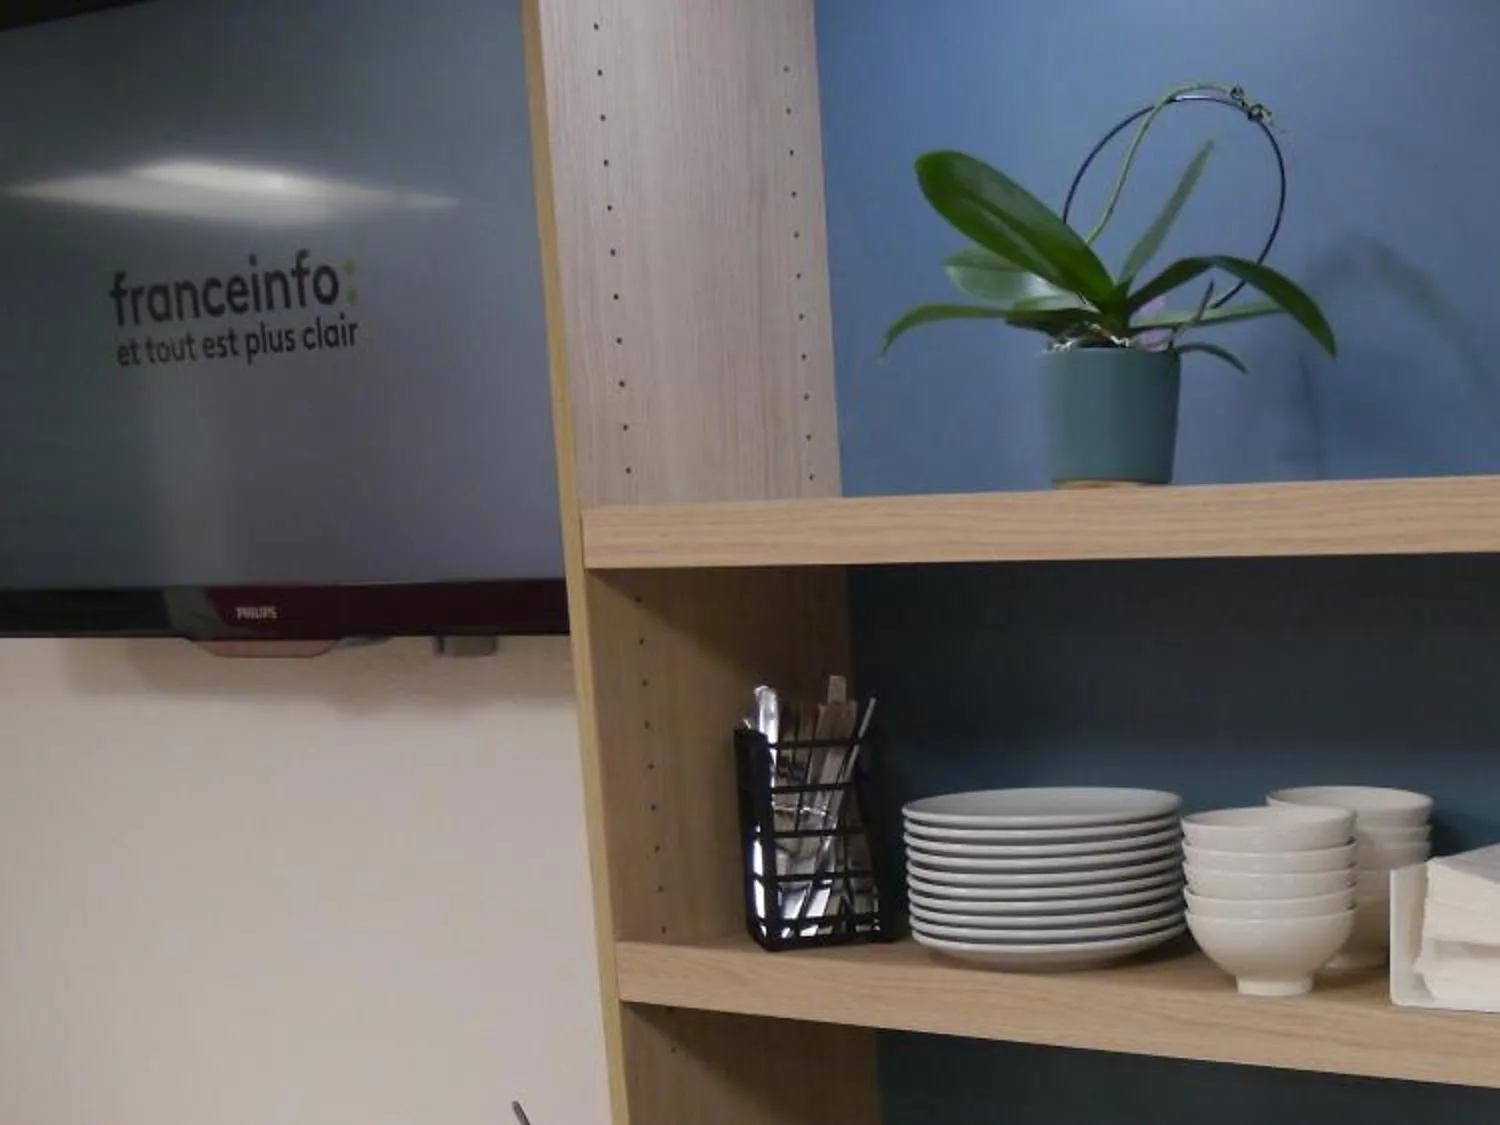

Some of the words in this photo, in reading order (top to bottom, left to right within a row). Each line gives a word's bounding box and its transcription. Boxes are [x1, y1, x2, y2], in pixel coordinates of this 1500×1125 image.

[116, 339, 141, 366] et
[145, 332, 197, 364] tout
[202, 328, 240, 359] est
[245, 320, 296, 365] plus
[303, 312, 359, 350] clair
[236, 605, 278, 620] PHILIPS
